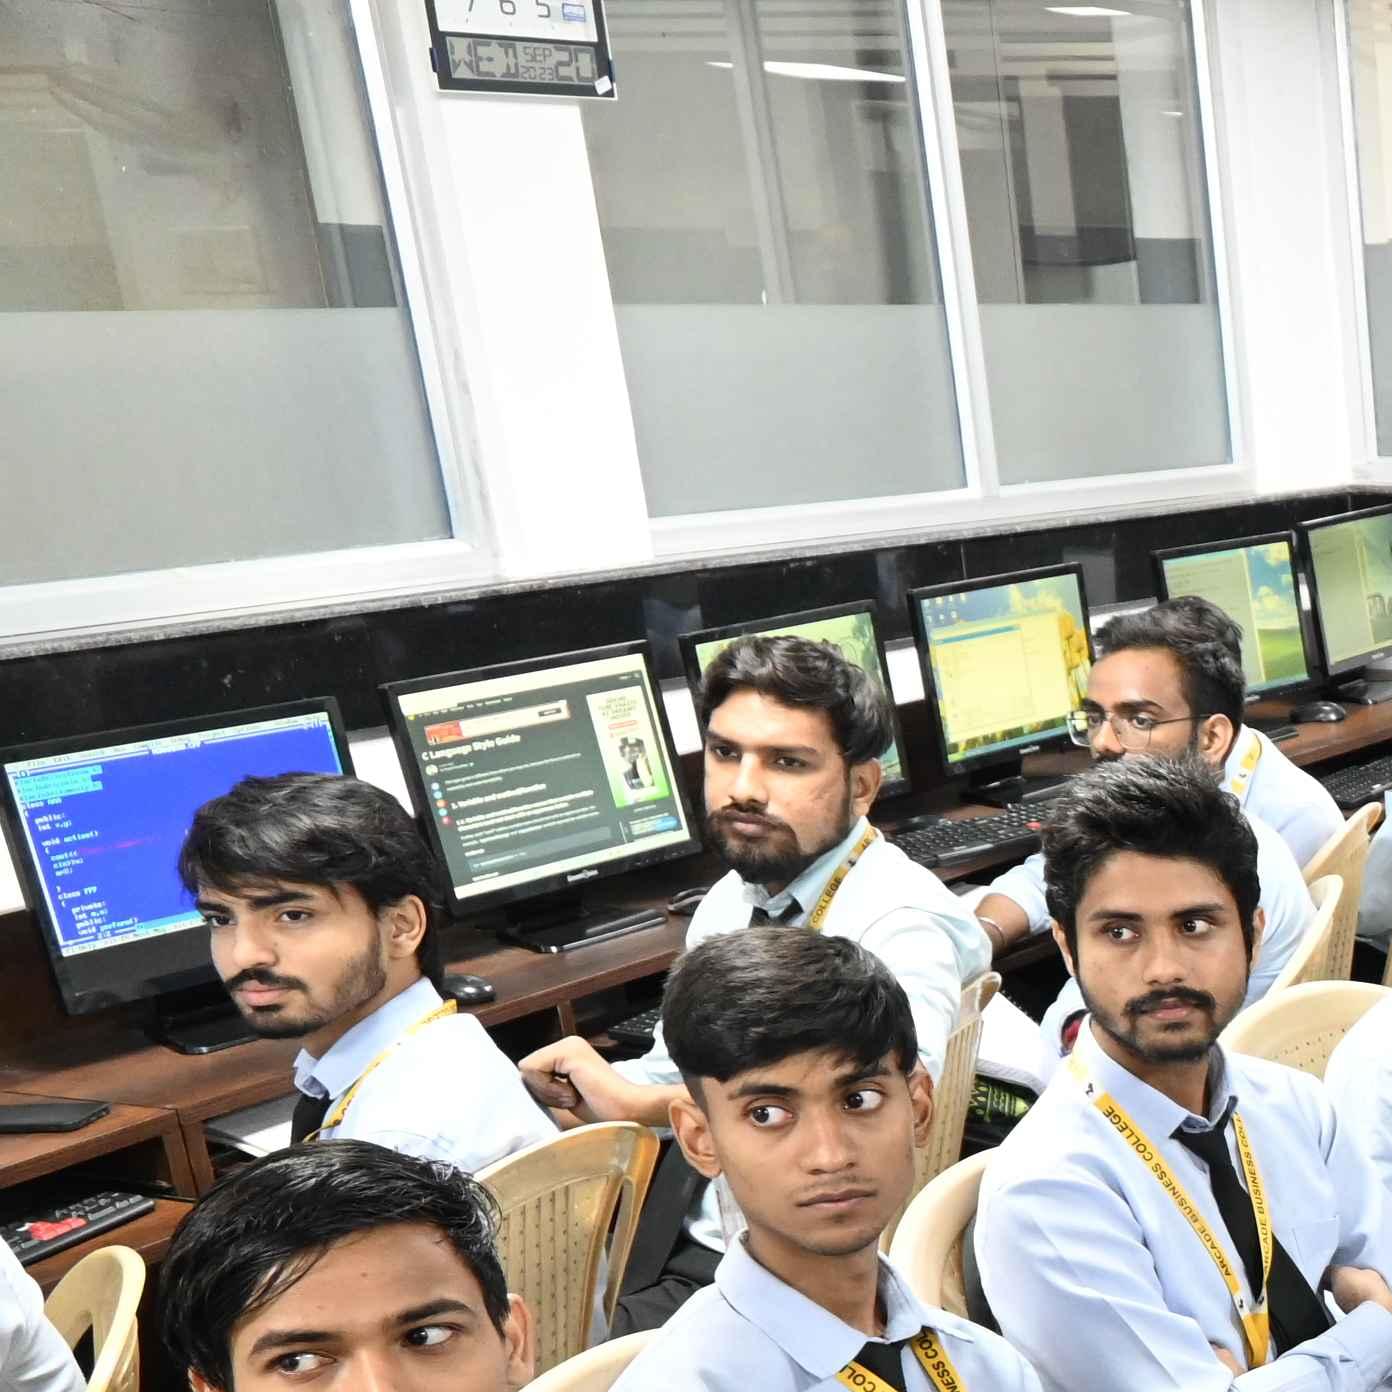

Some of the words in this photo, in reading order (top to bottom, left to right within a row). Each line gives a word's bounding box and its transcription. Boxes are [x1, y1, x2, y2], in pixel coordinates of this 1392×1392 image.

[451, 40, 519, 78] WED
[554, 46, 598, 82] 20
[520, 65, 554, 81] 2023
[522, 46, 552, 63] SEP
[422, 750, 430, 761] C
[430, 742, 473, 760] Language
[496, 734, 521, 748] Guide
[1102, 1105, 1154, 1163] COLLEGE
[1150, 1160, 1200, 1224] BUSINESS
[1247, 1150, 1267, 1215] BUSINESS
[1195, 1222, 1232, 1278] ARCADE
